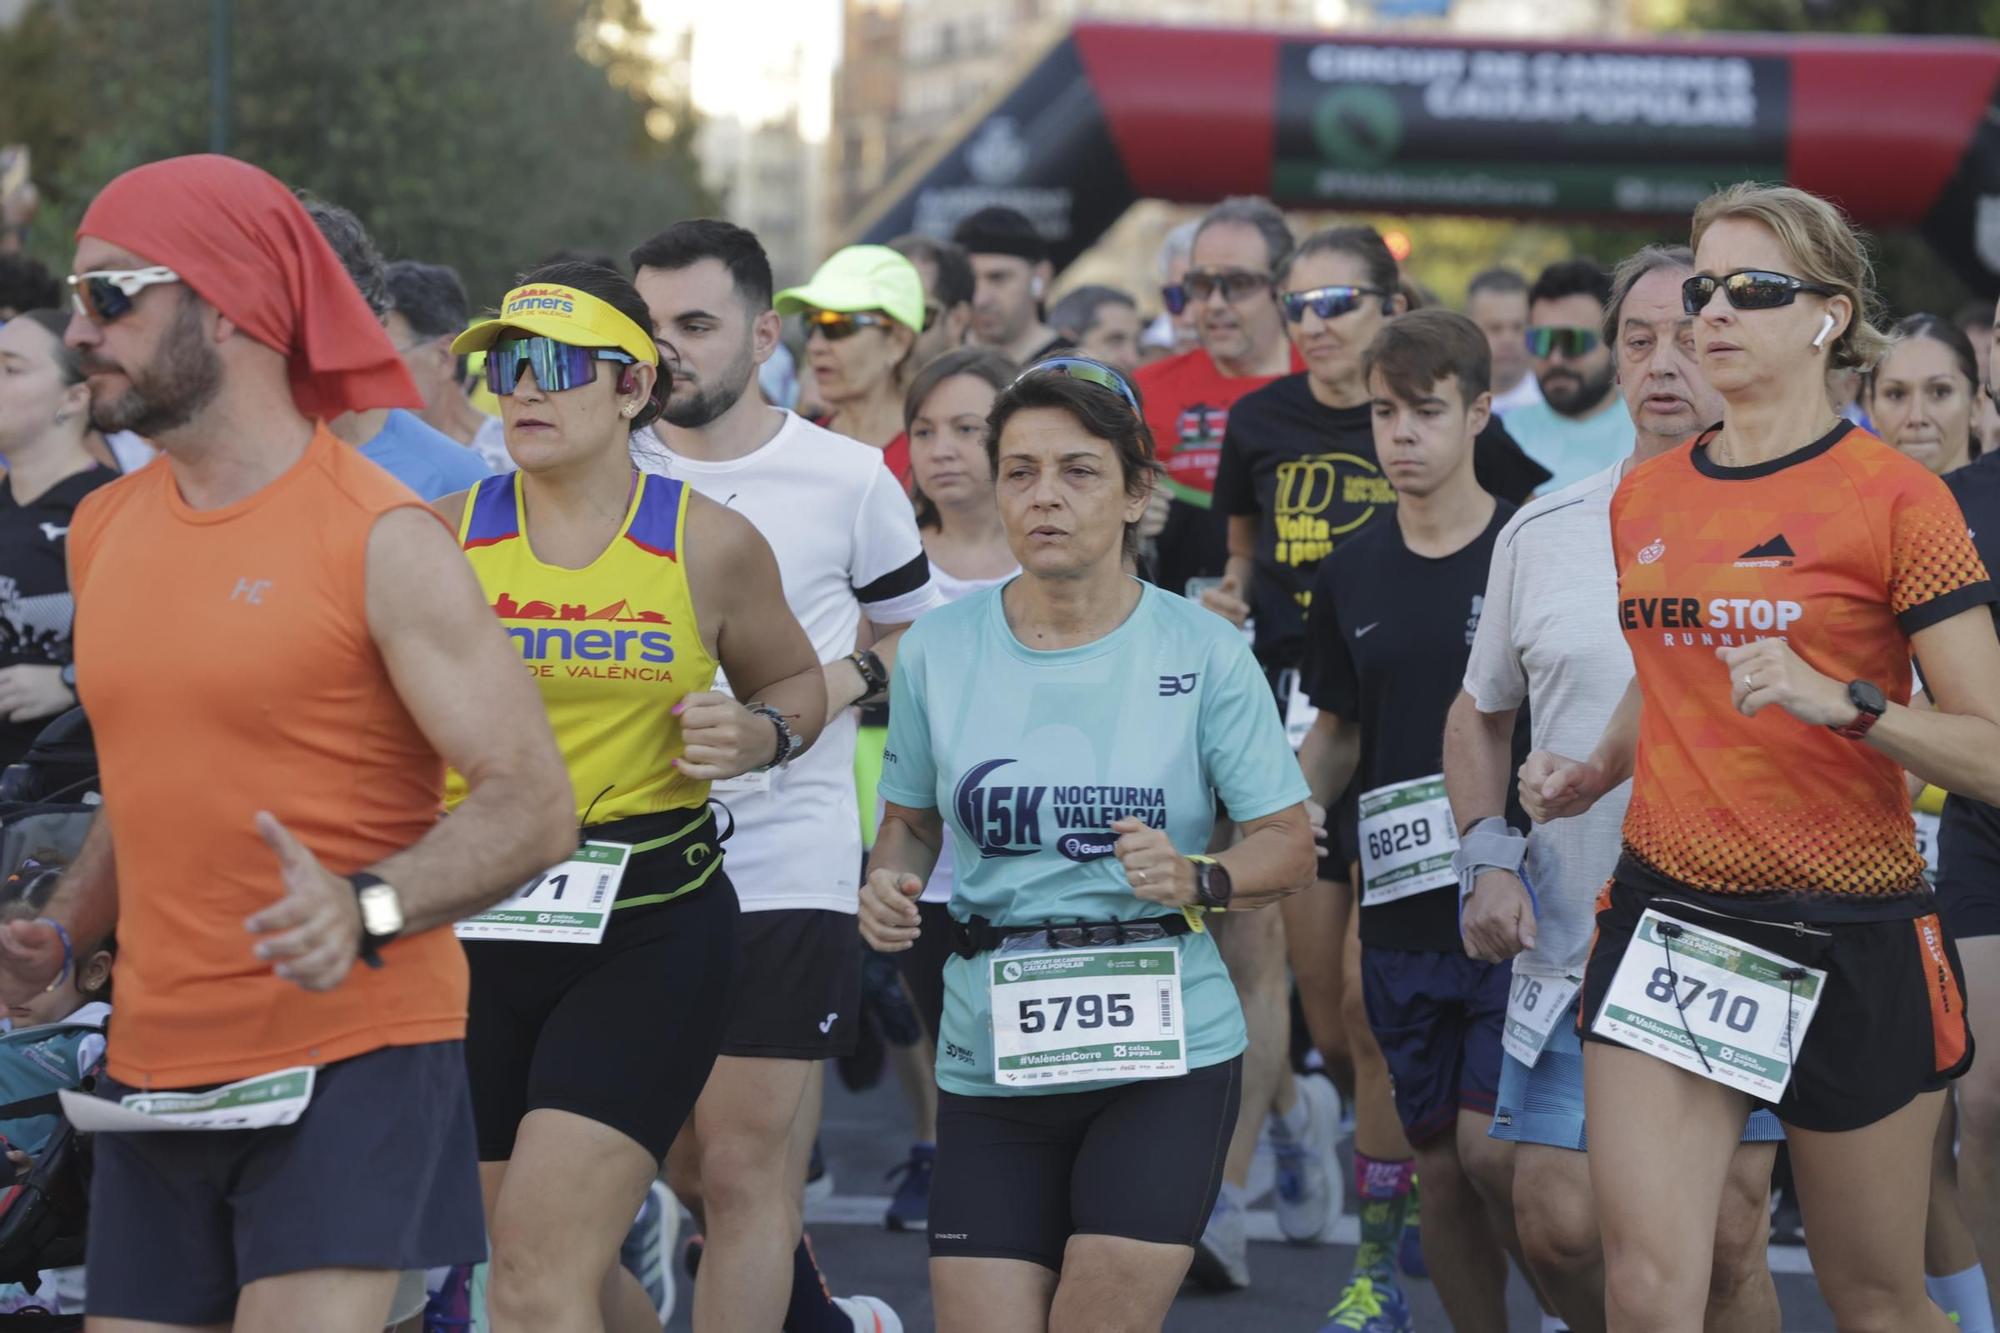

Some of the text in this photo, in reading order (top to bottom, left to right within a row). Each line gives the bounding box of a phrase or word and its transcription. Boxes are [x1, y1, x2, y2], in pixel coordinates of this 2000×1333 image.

[507, 298, 573, 314] runners
[1276, 513, 1330, 541] Volta
[1619, 598, 1803, 631] EVER STOP
[566, 663, 673, 683] VALÈNCIA
[970, 785, 1166, 847] 15K NOCTURNA
[1368, 817, 1432, 861] 6829
[1019, 993, 1135, 1034] 5795
[1645, 967, 1760, 1033] 8710
[1020, 1050, 1102, 1066] #ValènciaCorre
